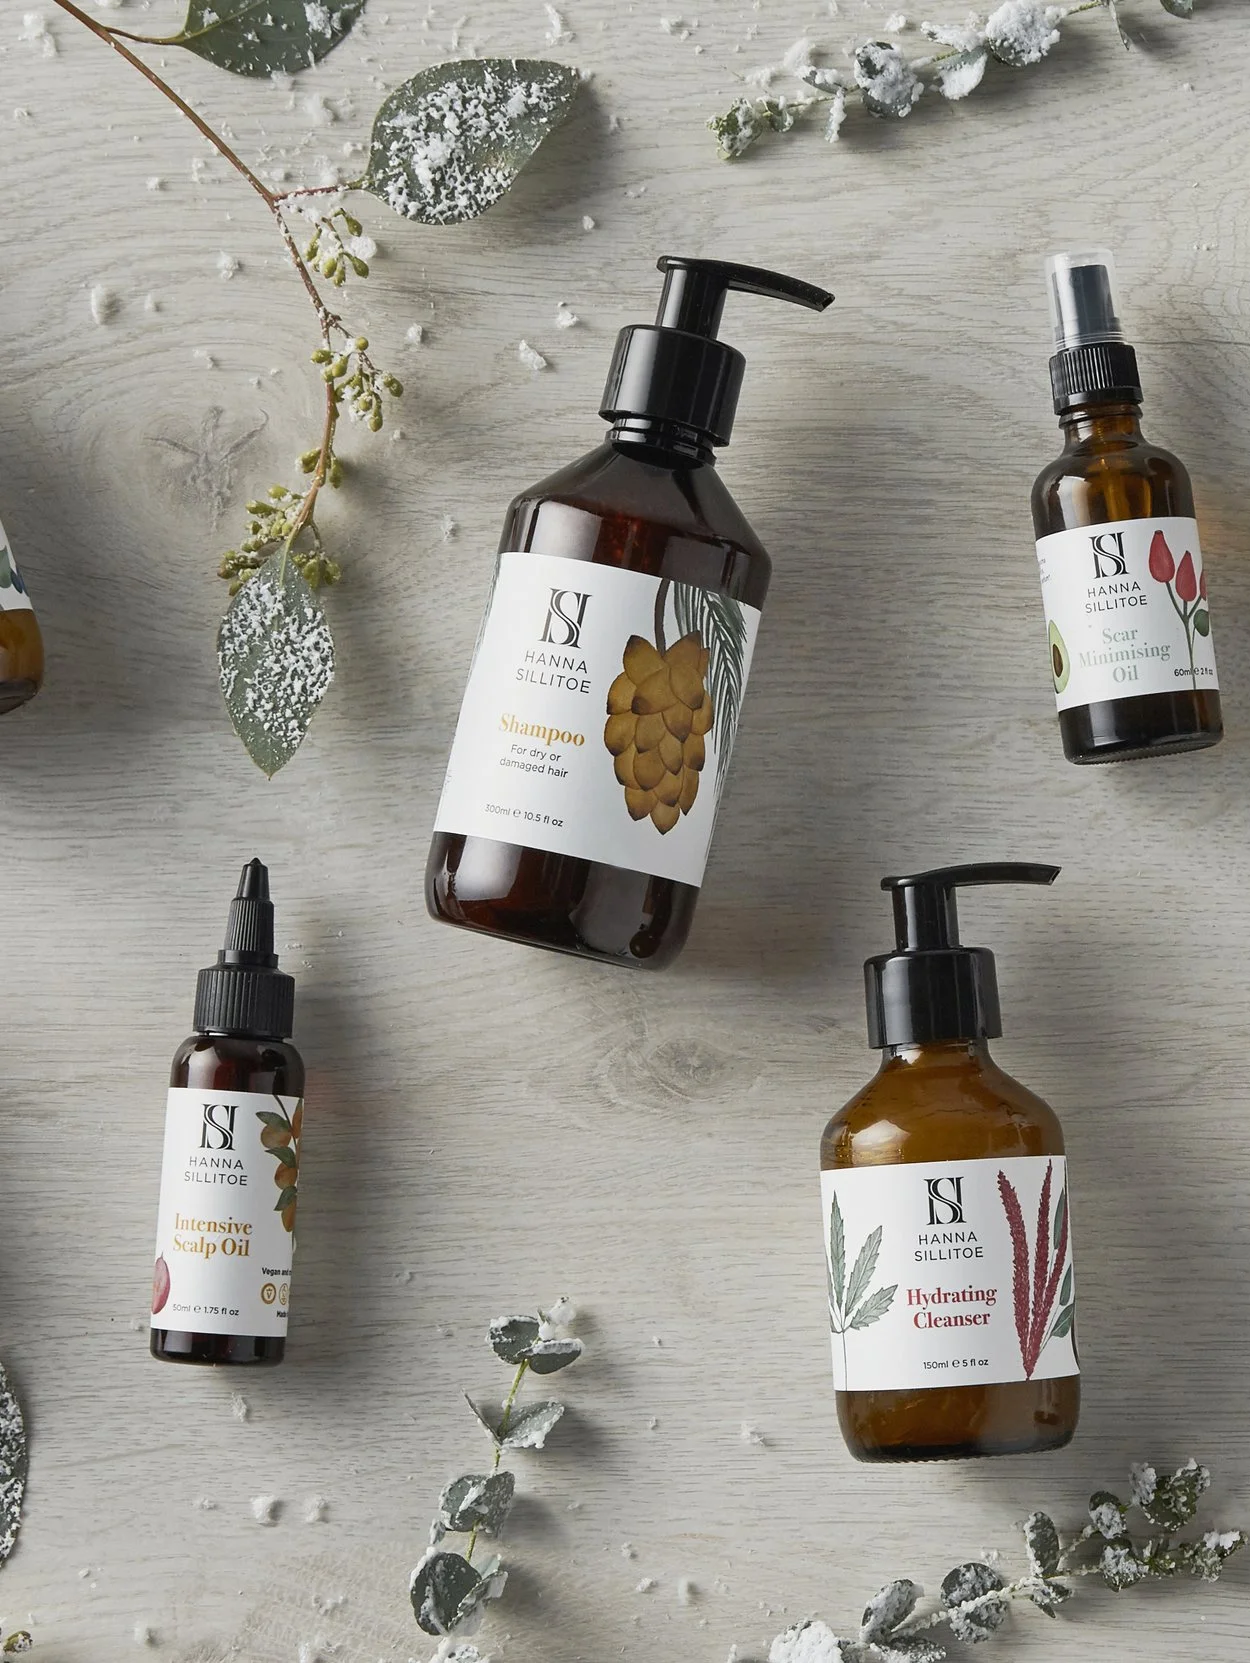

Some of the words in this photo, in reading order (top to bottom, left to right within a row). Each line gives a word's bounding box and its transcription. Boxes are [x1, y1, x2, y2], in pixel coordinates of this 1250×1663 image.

[1087, 581, 1141, 598] HANNA
[1085, 594, 1148, 613] SILLITOE
[1102, 627, 1138, 644] Scar
[525, 650, 588, 674] HANNA
[1079, 642, 1171, 668] Minimising
[516, 668, 591, 694] SILLITOE
[1113, 665, 1139, 683] Oil
[499, 712, 585, 748] Shampoo
[511, 744, 529, 757] For
[531, 746, 548, 763] dry
[550, 751, 562, 762] or
[500, 757, 545, 777] damaged
[547, 766, 569, 779] hair
[485, 803, 511, 818] 300ml
[523, 811, 543, 824] 10.5
[543, 815, 551, 825] fl
[552, 818, 564, 828] oz
[189, 1156, 244, 1170] HANNA
[184, 1171, 248, 1186] SILLITOE
[174, 1212, 253, 1236] Intensive
[172, 1233, 217, 1260] Scalp
[220, 1237, 250, 1257] Oil
[918, 1231, 978, 1245] HANNA
[914, 1246, 984, 1262] SILLITOE
[261, 1267, 281, 1277] Vegan
[907, 1284, 997, 1310] Hydrating
[173, 1304, 191, 1313] 50ml
[204, 1306, 219, 1315] 1.75
[221, 1306, 228, 1316] fl
[229, 1308, 240, 1316] oz
[913, 1310, 991, 1329] Cleanser
[923, 1360, 949, 1370] 150ml
[962, 1359, 969, 1368] 5
[970, 1358, 977, 1367] fl
[978, 1358, 989, 1367] oz
